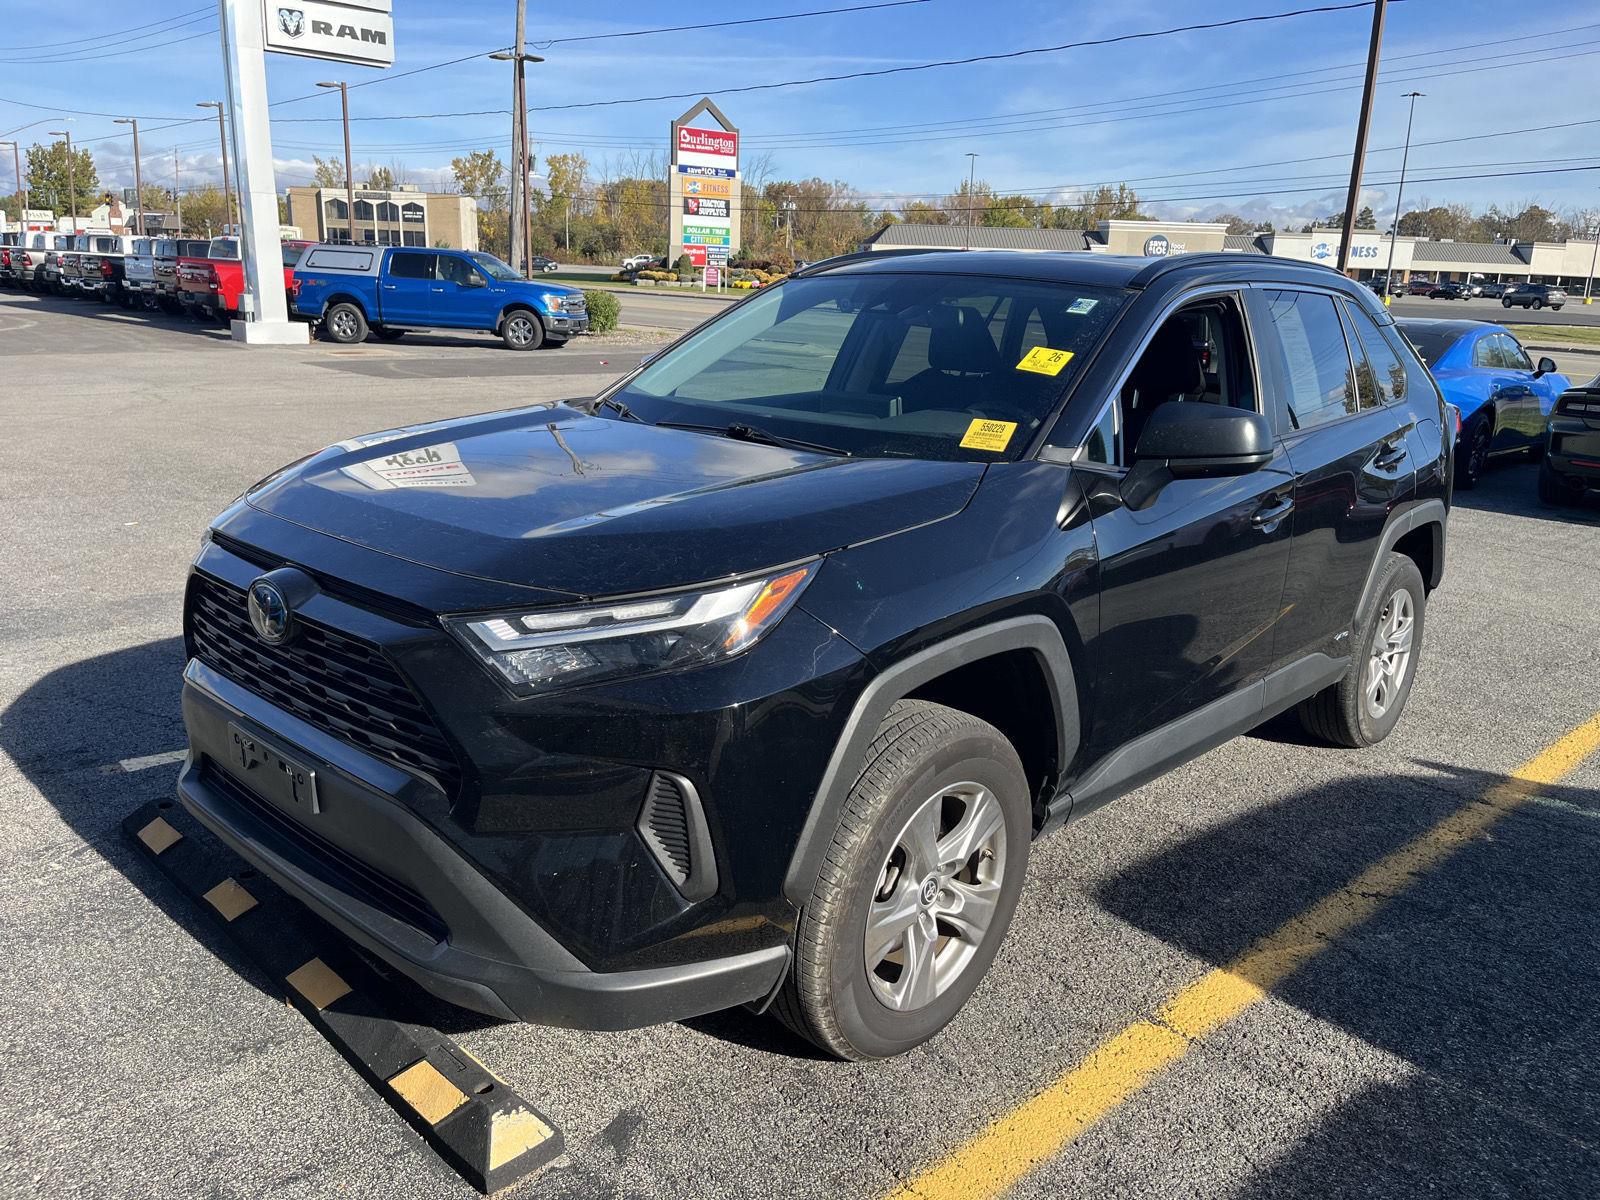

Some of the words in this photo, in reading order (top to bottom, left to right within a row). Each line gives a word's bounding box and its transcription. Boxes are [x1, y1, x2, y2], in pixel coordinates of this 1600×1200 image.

[312, 20, 386, 45] RAM
[680, 129, 733, 149] Burlington
[703, 183, 729, 193] FITNESS
[699, 198, 726, 208] TRACTOR
[1152, 246, 1167, 255] lot
[1170, 242, 1185, 250] food
[1047, 352, 1064, 363] 26
